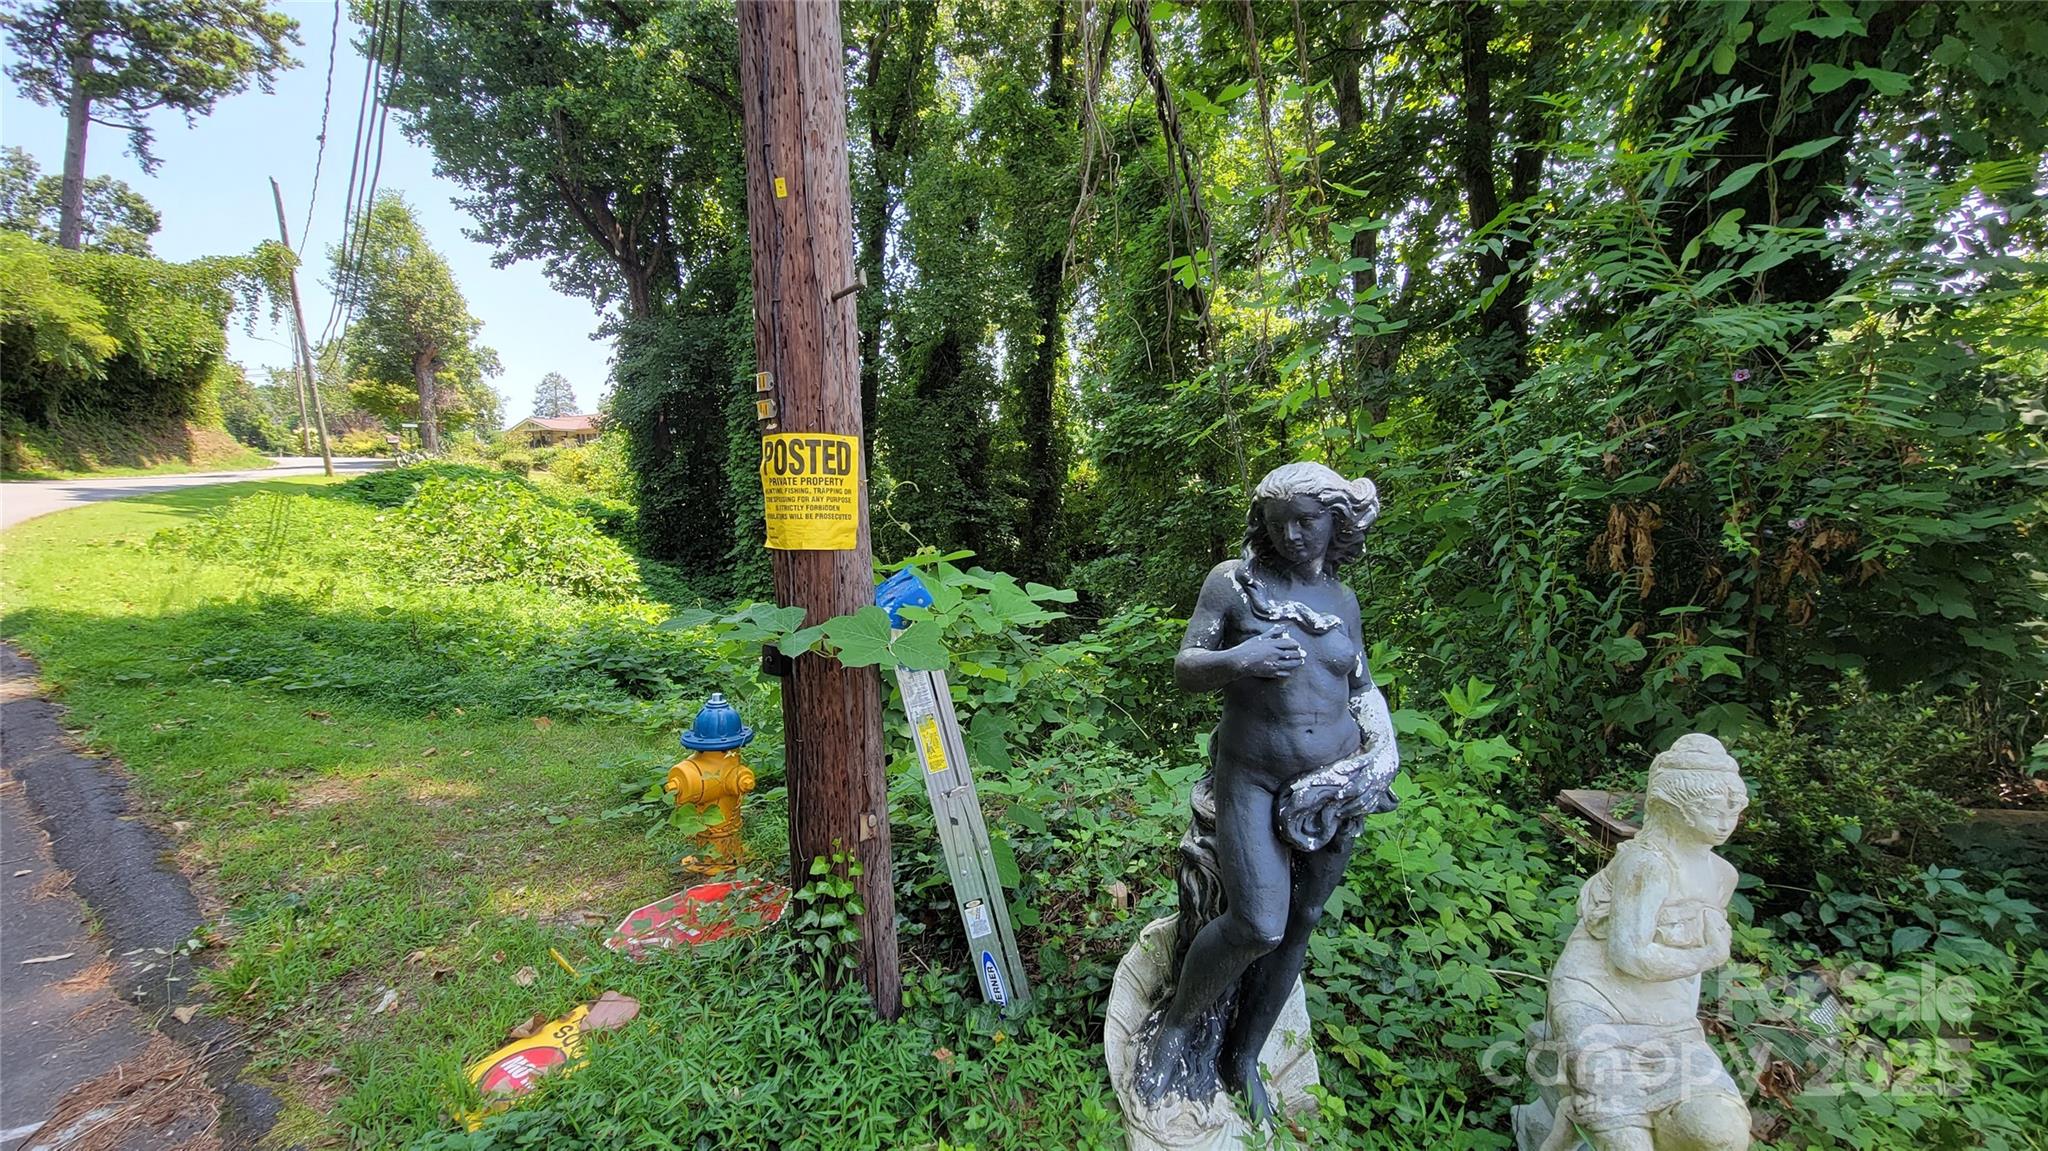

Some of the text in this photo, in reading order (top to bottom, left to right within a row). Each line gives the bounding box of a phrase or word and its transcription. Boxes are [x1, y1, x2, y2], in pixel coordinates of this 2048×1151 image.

[764, 438, 851, 476] POSTED
[769, 476, 844, 487] PRIVATE PROPERTY
[813, 487, 842, 495] TRAPPING
[825, 496, 851, 504] PURPOSE
